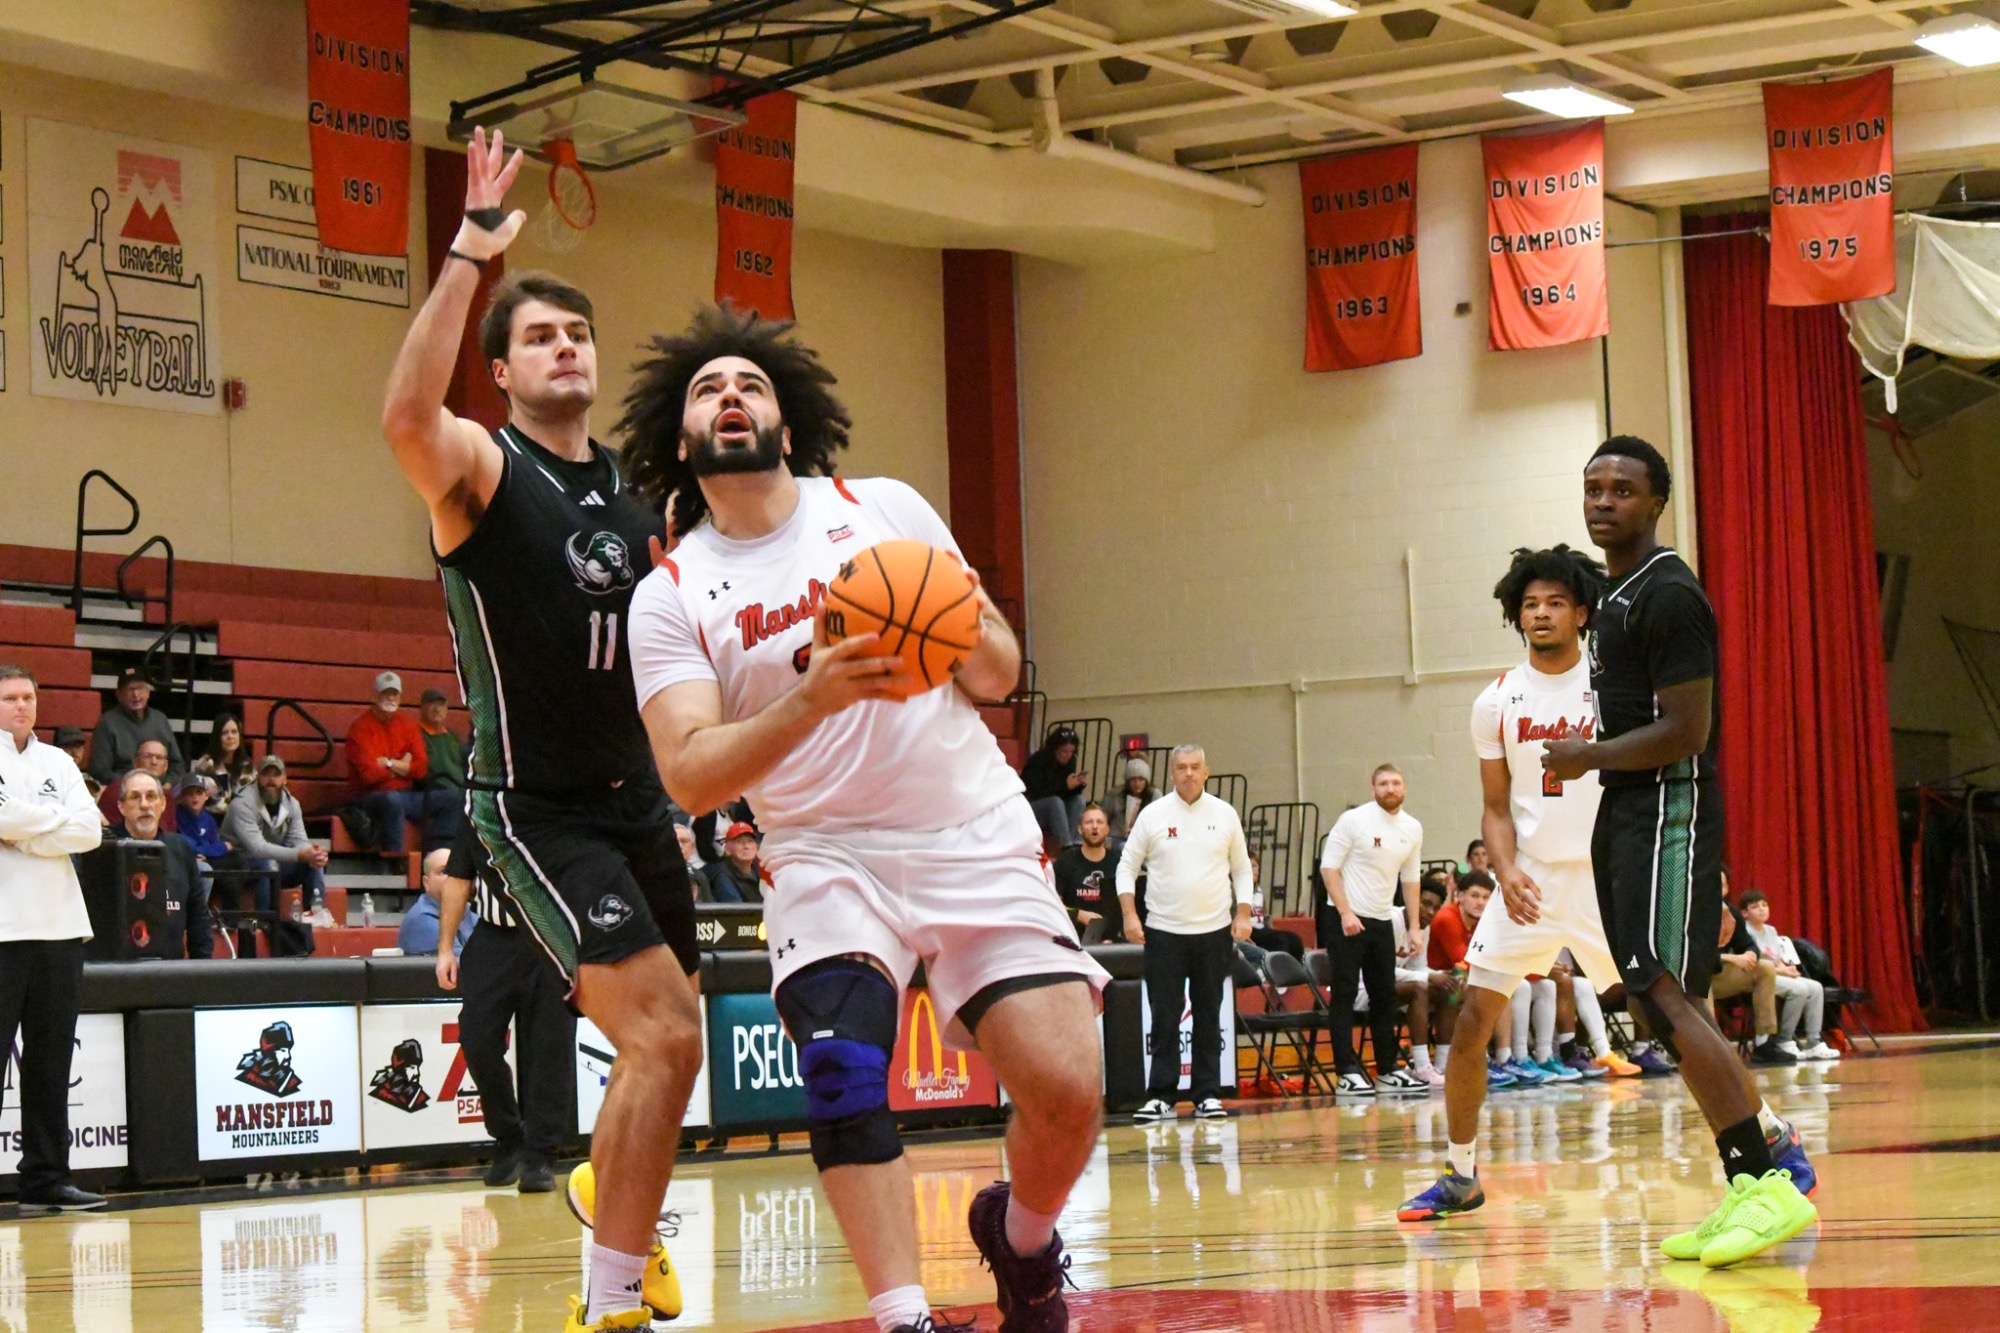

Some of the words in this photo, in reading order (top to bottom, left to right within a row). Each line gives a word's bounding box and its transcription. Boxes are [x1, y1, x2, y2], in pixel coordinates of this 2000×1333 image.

[314, 31, 404, 75] DIVISION
[308, 101, 411, 143] CHAMPIONS
[1773, 116, 1885, 149] DIVISION
[718, 129, 792, 161] DIVISION
[269, 179, 299, 204] PSAC
[342, 176, 382, 207] 1961
[1312, 180, 1410, 214] DIVISION
[1492, 164, 1598, 199] DIVISION
[1772, 173, 1893, 206] CHAMPIONS
[1308, 234, 1415, 267] CHAMPIONS
[1489, 220, 1602, 254] CHAMPIONS
[1800, 236, 1858, 260] 1975
[244, 242, 315, 275] NATIONAL
[316, 253, 405, 289] TOURNAMENT
[735, 248, 774, 276] 1962
[1336, 296, 1389, 319] 1963
[1522, 283, 1577, 306] 1964
[39, 316, 216, 398] VOLLEYBALL
[734, 577, 827, 652] Mansf
[588, 610, 617, 670] 11
[737, 925, 758, 937] BONUS
[915, 1085, 964, 1102] McDonald's
[216, 1099, 334, 1132] MANSFIELD
[232, 1129, 320, 1149] MOUNTAINEERS
